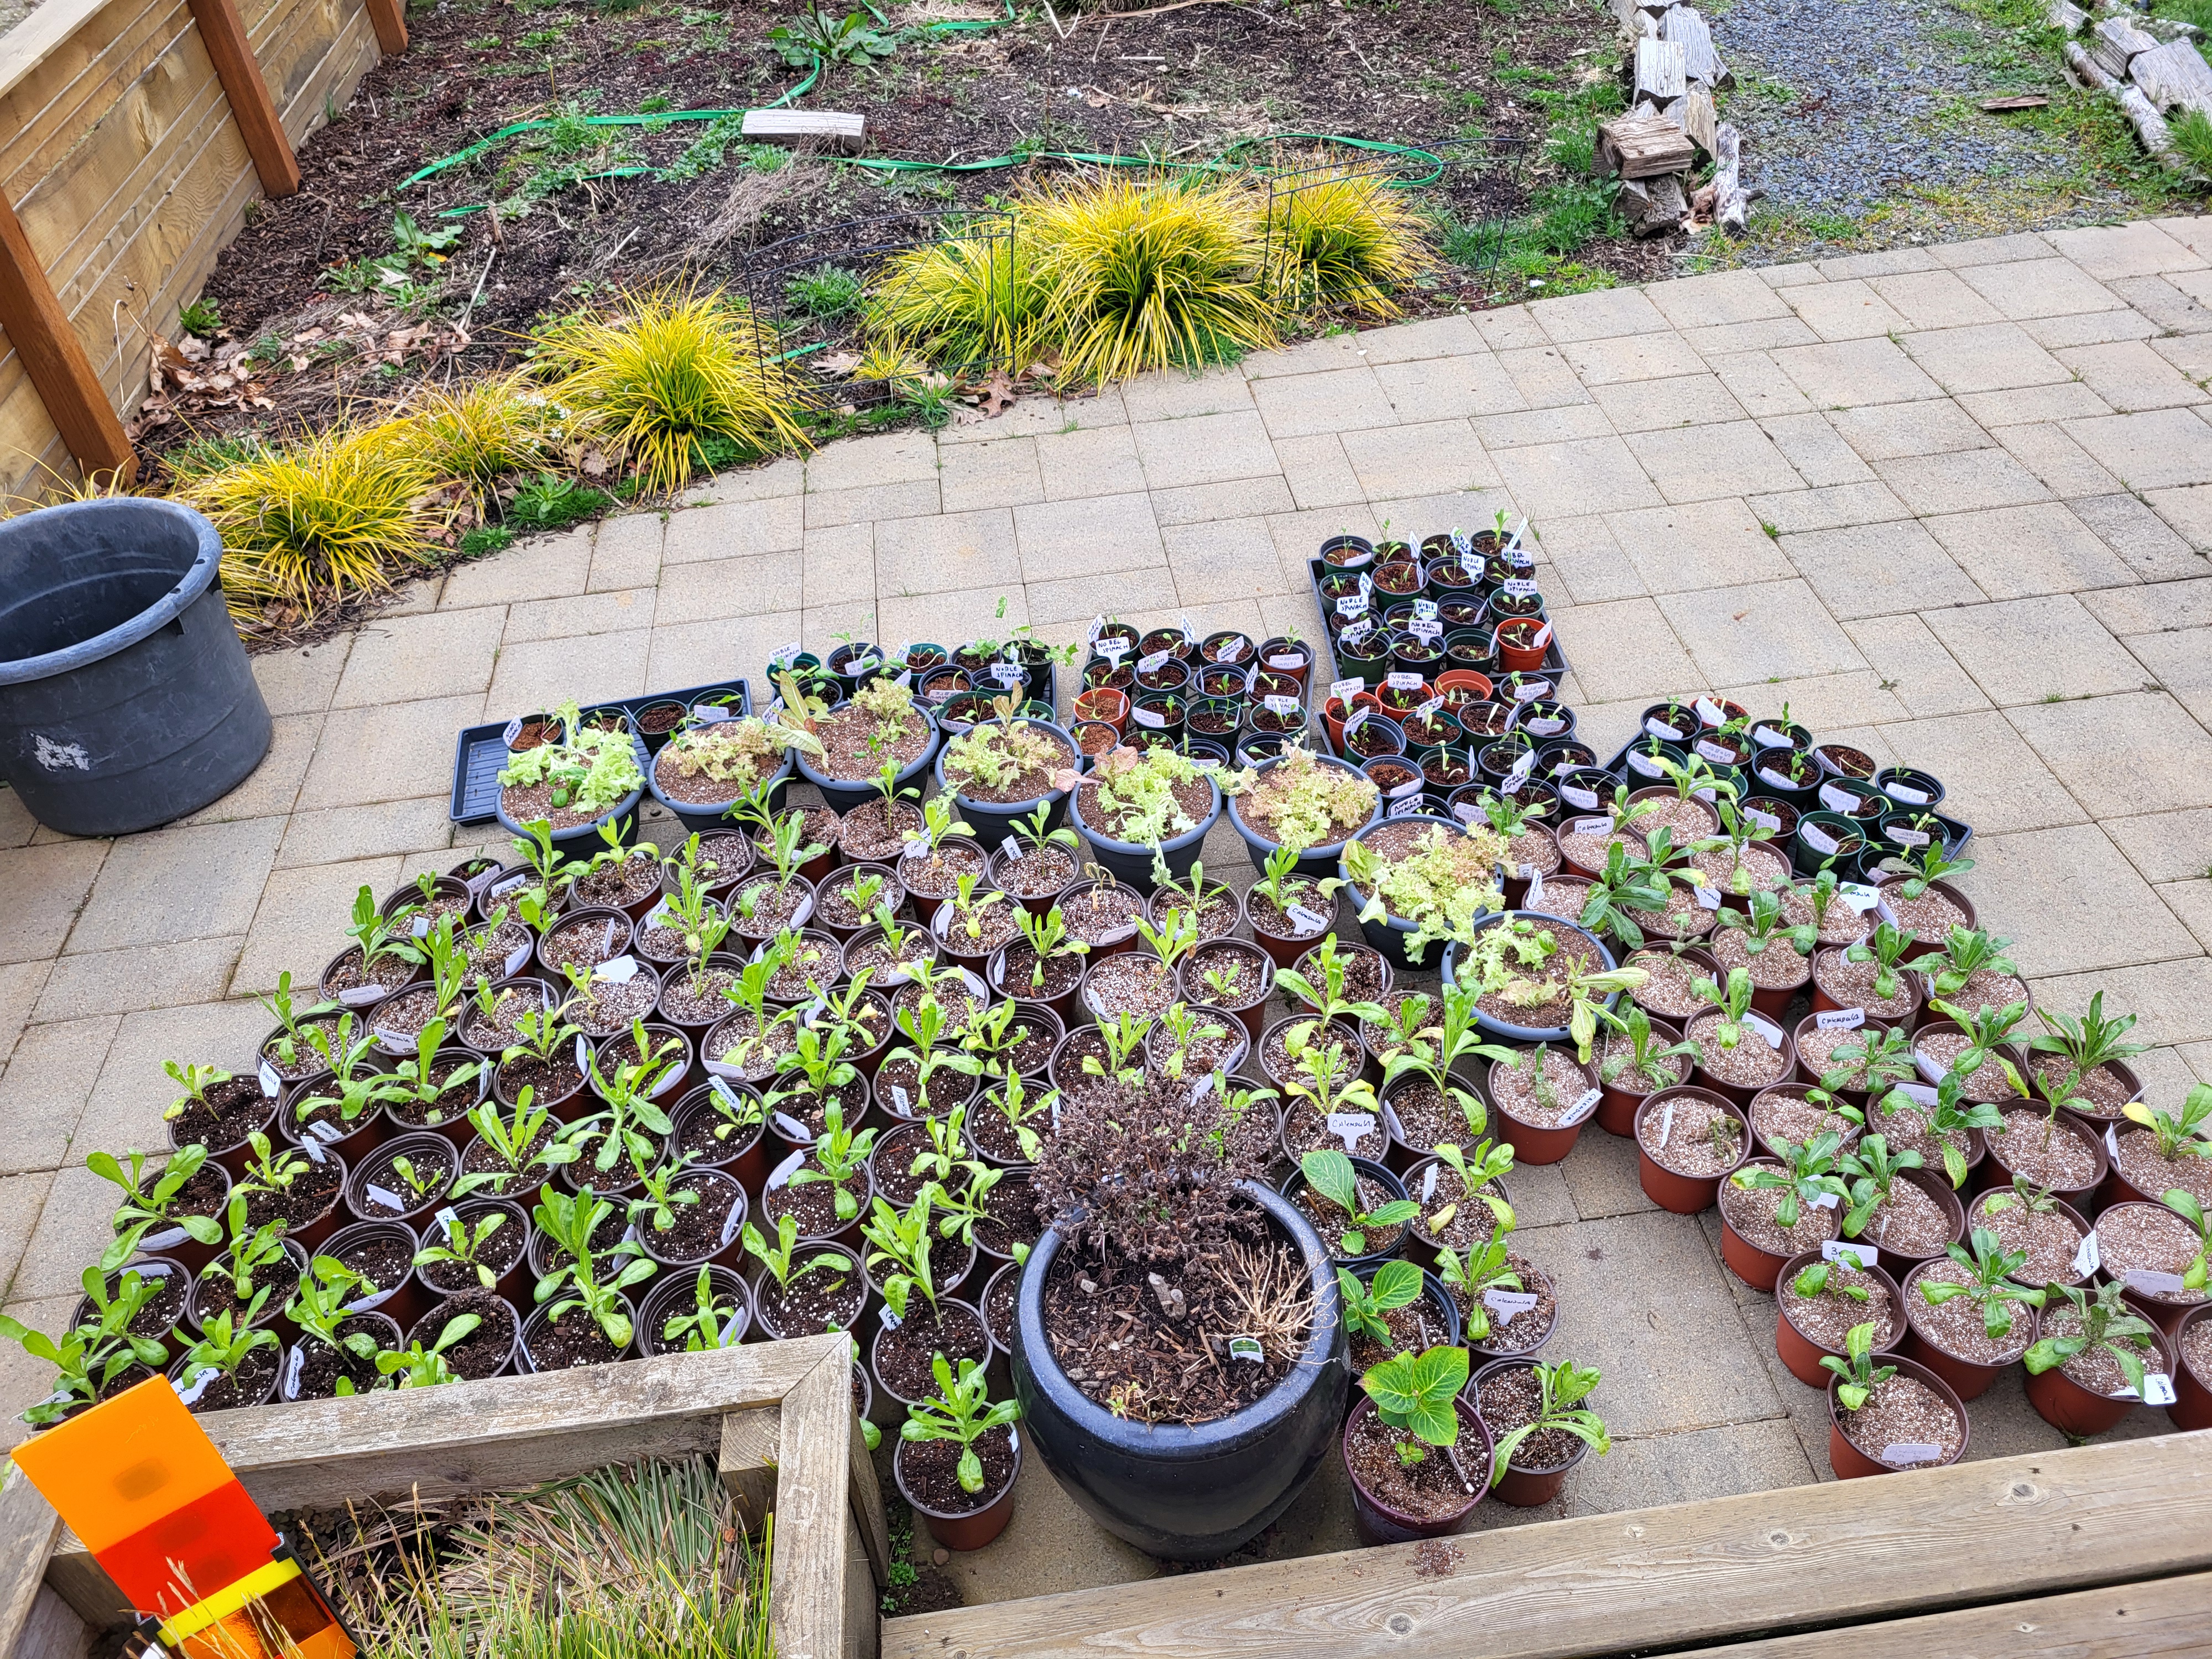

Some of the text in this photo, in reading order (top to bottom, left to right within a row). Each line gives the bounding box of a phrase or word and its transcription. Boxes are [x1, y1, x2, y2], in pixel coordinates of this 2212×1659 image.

[1340, 596, 1363, 605] NOBLE
[772, 646, 790, 656] NOBLE
[1103, 645, 1128, 653] SPINACH
[1341, 685, 1360, 693] PINACH
[1505, 769, 1526, 786] NOBLE
[1395, 797, 1418, 811] NOBLE
